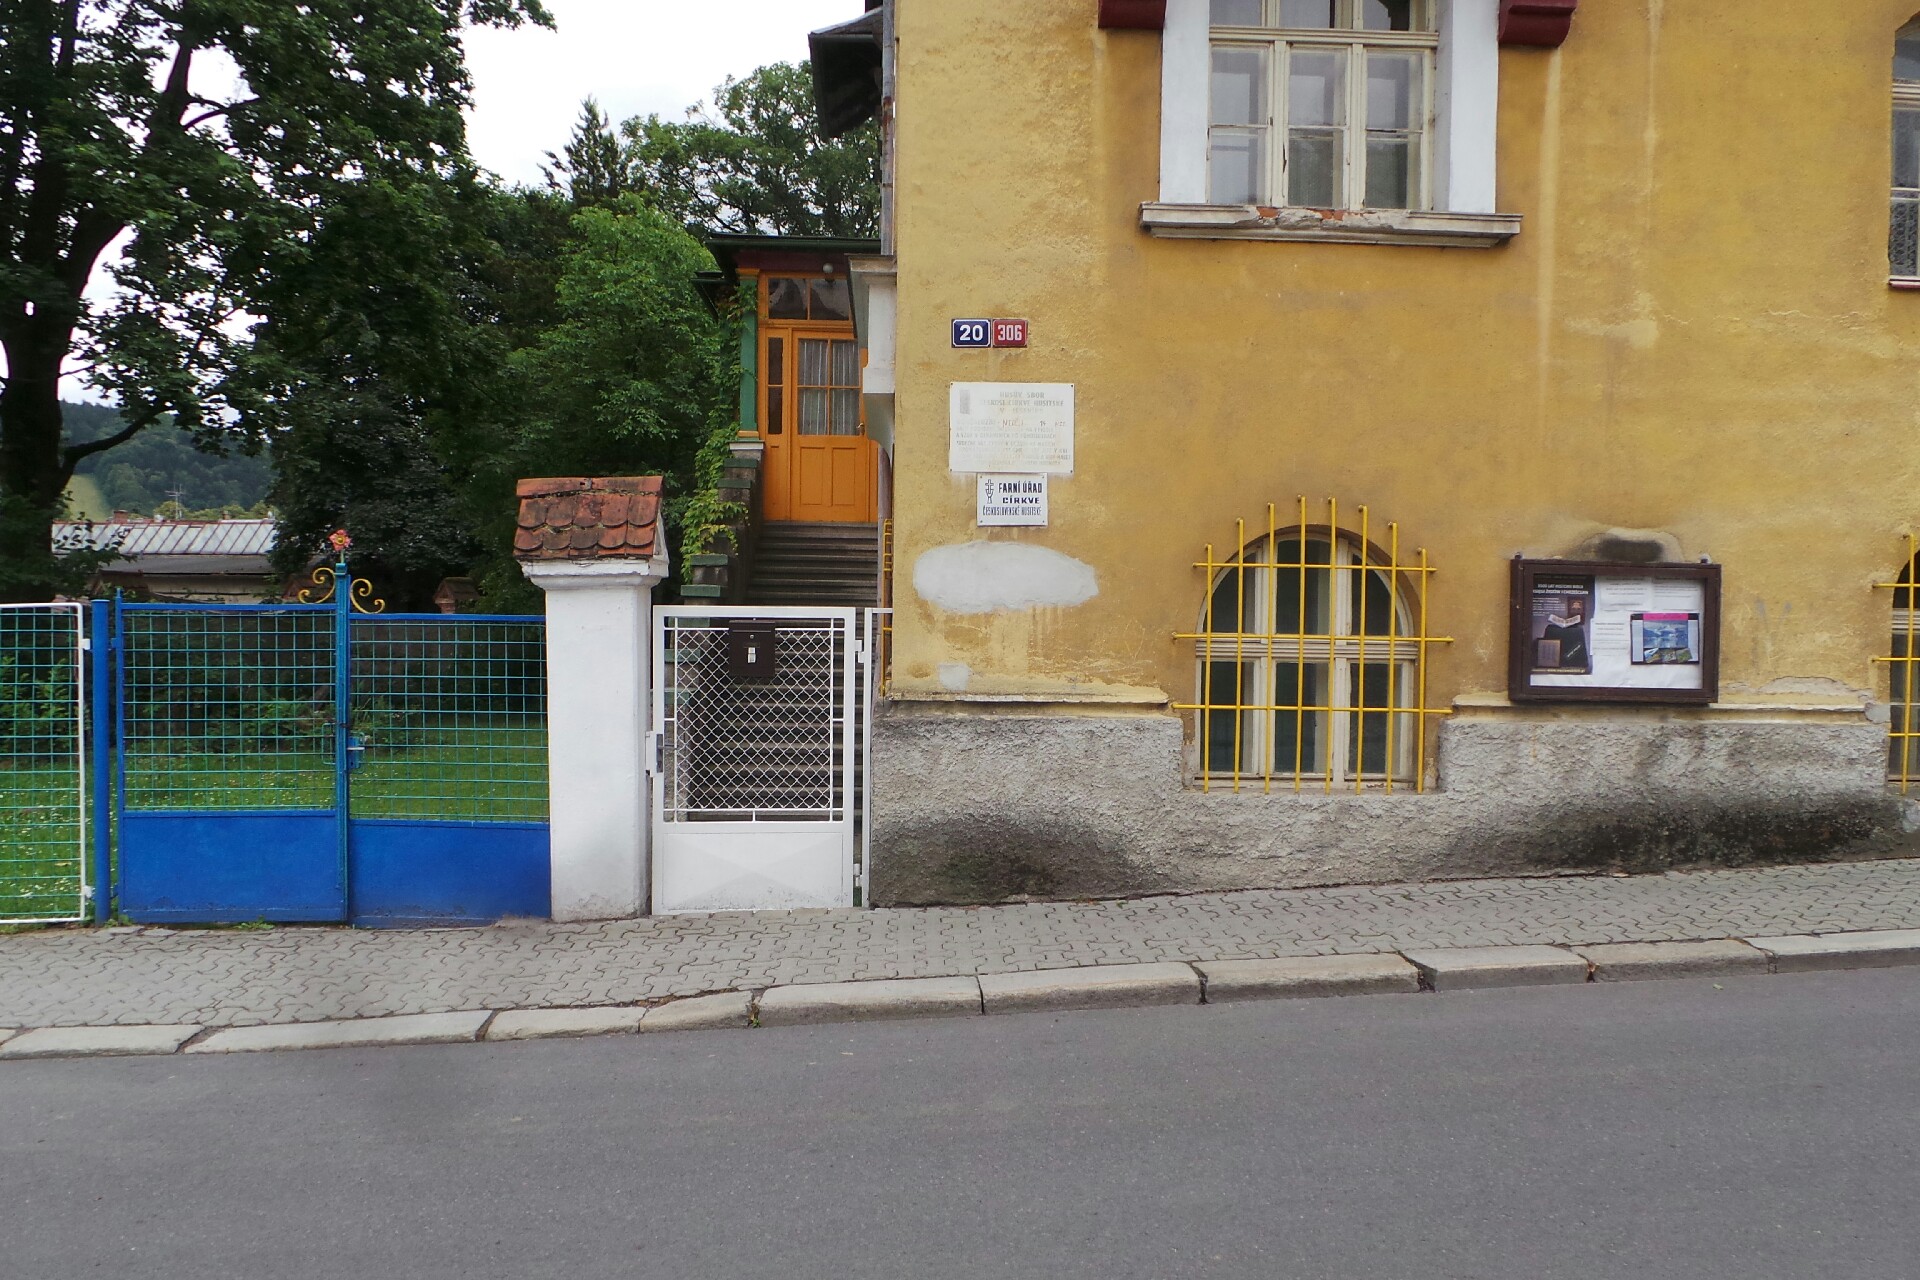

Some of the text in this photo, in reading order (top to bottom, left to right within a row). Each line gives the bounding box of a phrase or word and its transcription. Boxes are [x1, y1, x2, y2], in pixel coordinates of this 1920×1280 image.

[959, 324, 983, 341] 20
[997, 324, 1022, 341] 306
[998, 480, 1043, 493] FARNÍ ÚŘAD
[1002, 495, 1040, 504] CÍRKVE
[982, 505, 1042, 516] ČESKOSLOVENSKÉ HUSITSKÉ
